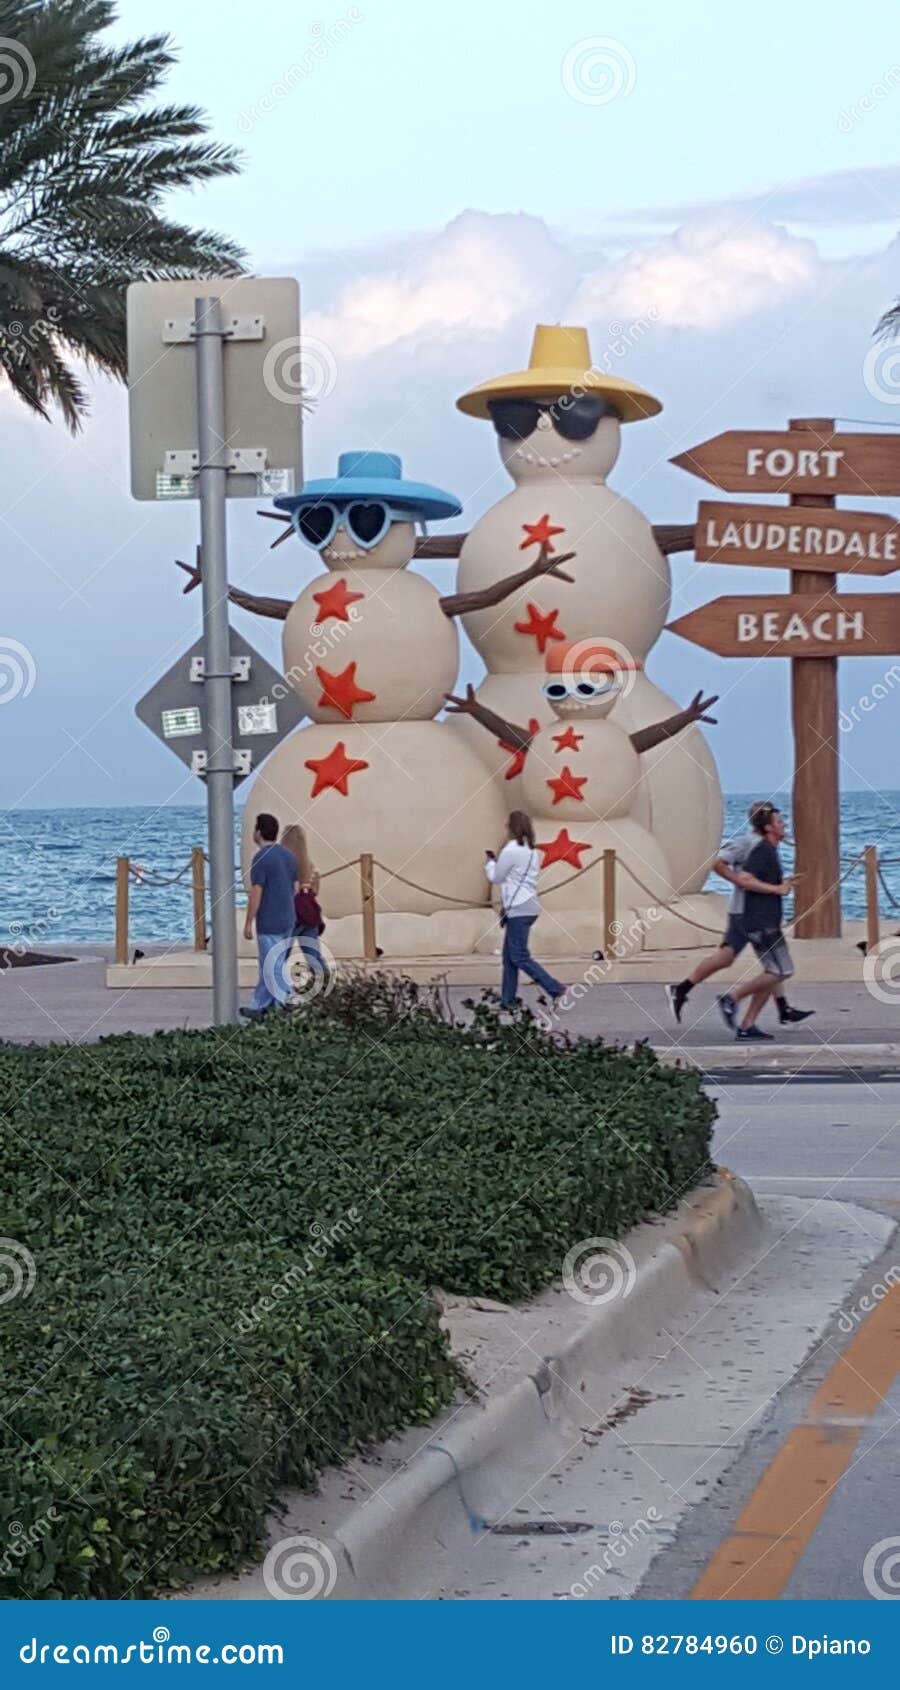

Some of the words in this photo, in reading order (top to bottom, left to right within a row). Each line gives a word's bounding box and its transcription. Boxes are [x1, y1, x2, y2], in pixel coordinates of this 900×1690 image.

[747, 449, 844, 477] FORT
[706, 520, 897, 560] LAUDERDALE
[737, 612, 864, 642] BEACH
